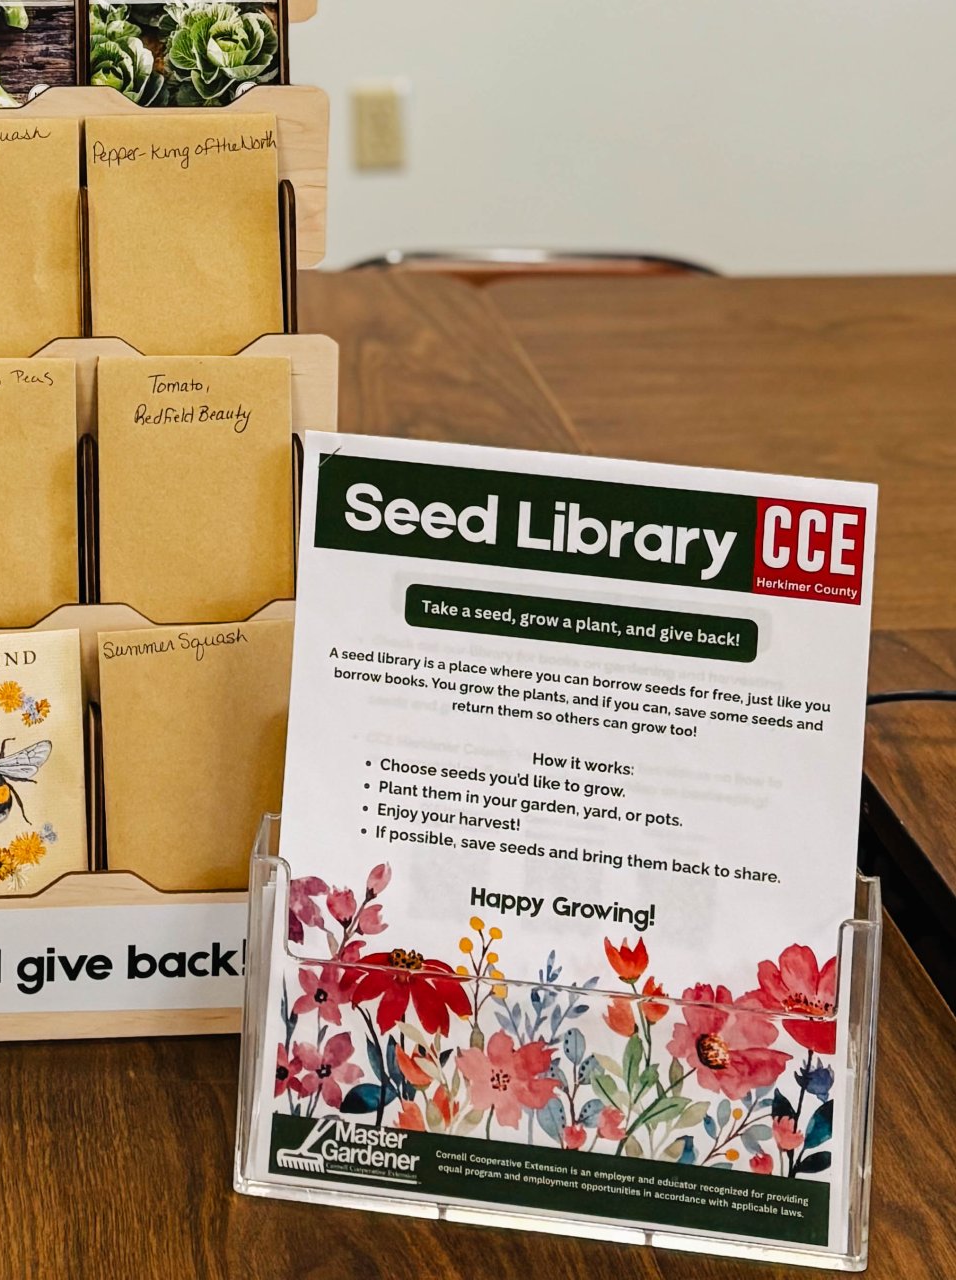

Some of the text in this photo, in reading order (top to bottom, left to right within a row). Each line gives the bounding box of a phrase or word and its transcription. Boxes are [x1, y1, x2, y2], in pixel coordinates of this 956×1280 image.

[151, 145, 190, 169] King
[13, 369, 54, 386] Peas
[147, 374, 210, 394] Tomato,
[134, 405, 253, 432] Redfield Beauty
[345, 483, 737, 580] Seed Library
[763, 506, 858, 575] CCE
[757, 577, 857, 599] Herkimer County
[422, 600, 739, 646] Take a seed, grow a plant, and give back!
[103, 628, 248, 661] Summer Squash
[381, 759, 624, 797] Choose seeds you'd like to grow.
[533, 753, 633, 775] How it works:
[378, 803, 520, 830] Enjoy your harvest!
[471, 887, 655, 931] Happy Growing!
[17, 948, 112, 994] give
[335, 1121, 407, 1149] Master
[322, 1139, 420, 1172] Gardener
[436, 1150, 466, 1160] Cornell
[470, 1154, 522, 1168] Cooperative
[525, 1161, 567, 1173] Extension
[571, 1167, 577, 1175] is
[594, 1172, 634, 1182] employer
[658, 1179, 696, 1190] educator
[700, 1185, 748, 1196] recognized
[752, 1190, 764, 1198] for
[767, 1194, 808, 1206] providing
